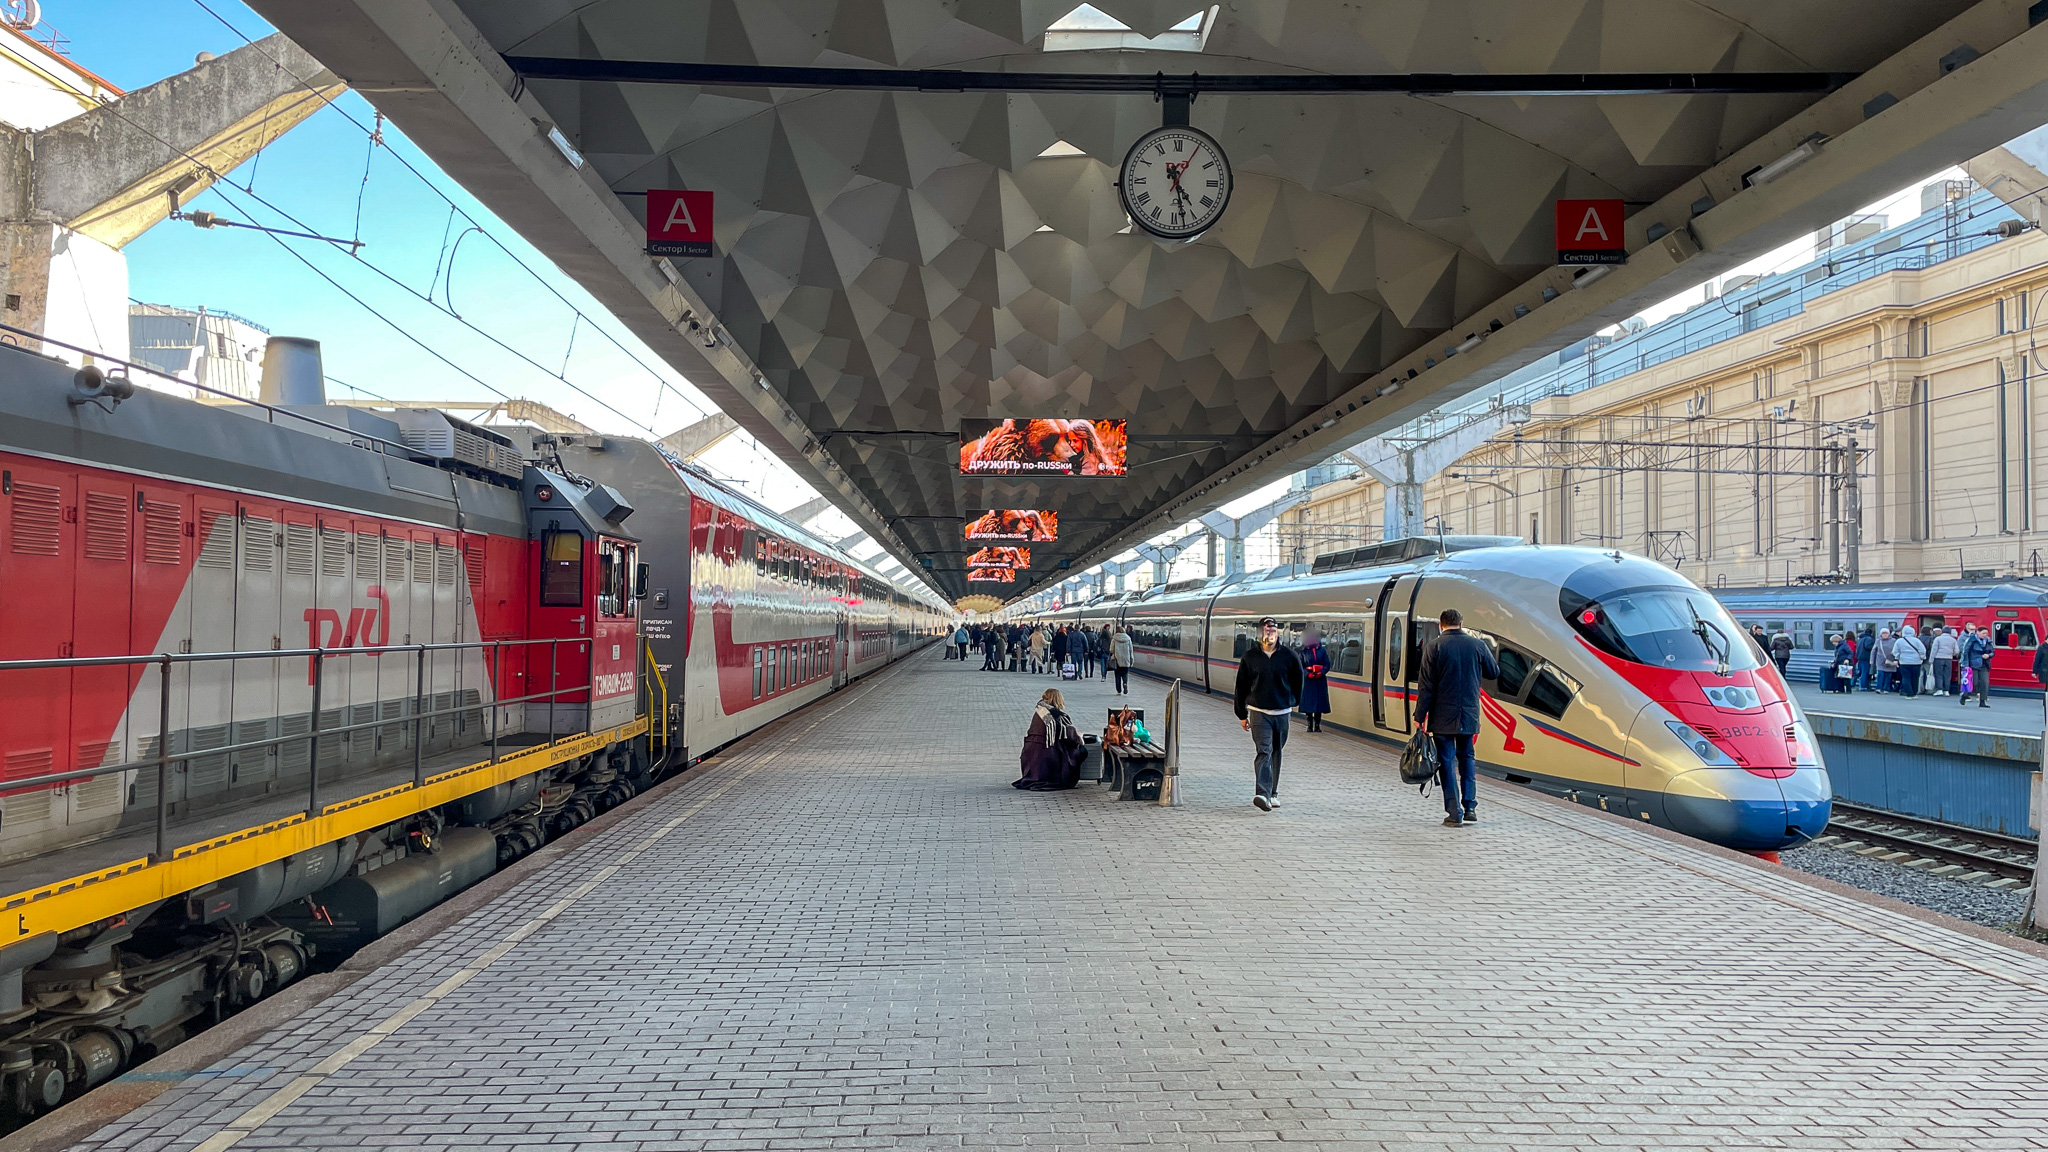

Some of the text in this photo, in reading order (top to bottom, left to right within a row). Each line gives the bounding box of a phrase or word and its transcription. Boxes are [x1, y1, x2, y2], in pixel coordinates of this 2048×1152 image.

[1155, 143, 1166, 156] XI
[1173, 140, 1183, 152] XII
[1140, 158, 1152, 167] X
[1202, 161, 1214, 170] II
[1137, 191, 1151, 206] VIII
[652, 245, 683, 254] Сектор
[1563, 253, 1595, 262] Сектор
[969, 460, 1072, 470] ДРУЖИТЬ по-RUSSки
